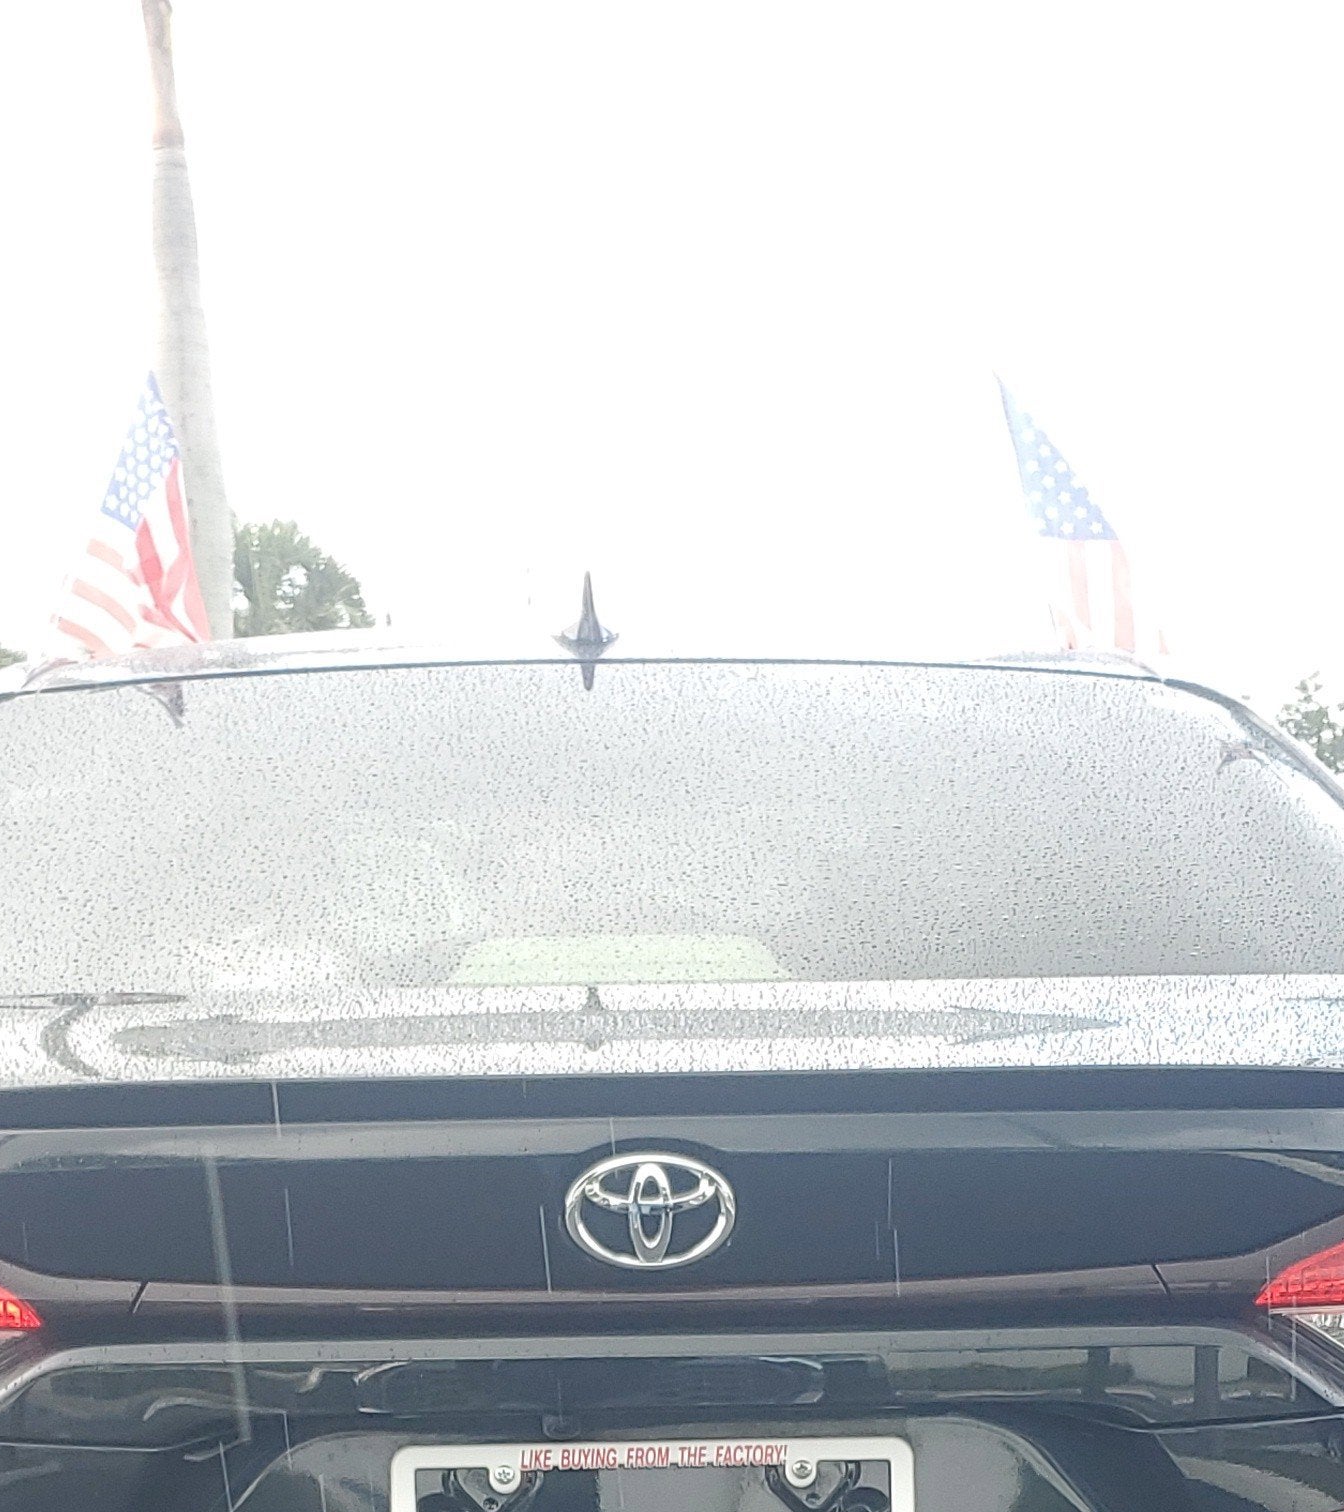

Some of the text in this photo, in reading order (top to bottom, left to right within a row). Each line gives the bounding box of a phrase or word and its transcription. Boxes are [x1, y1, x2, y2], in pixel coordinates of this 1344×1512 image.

[520, 1444, 788, 1470] LIKE BUYING FROM THE FACTORY!
